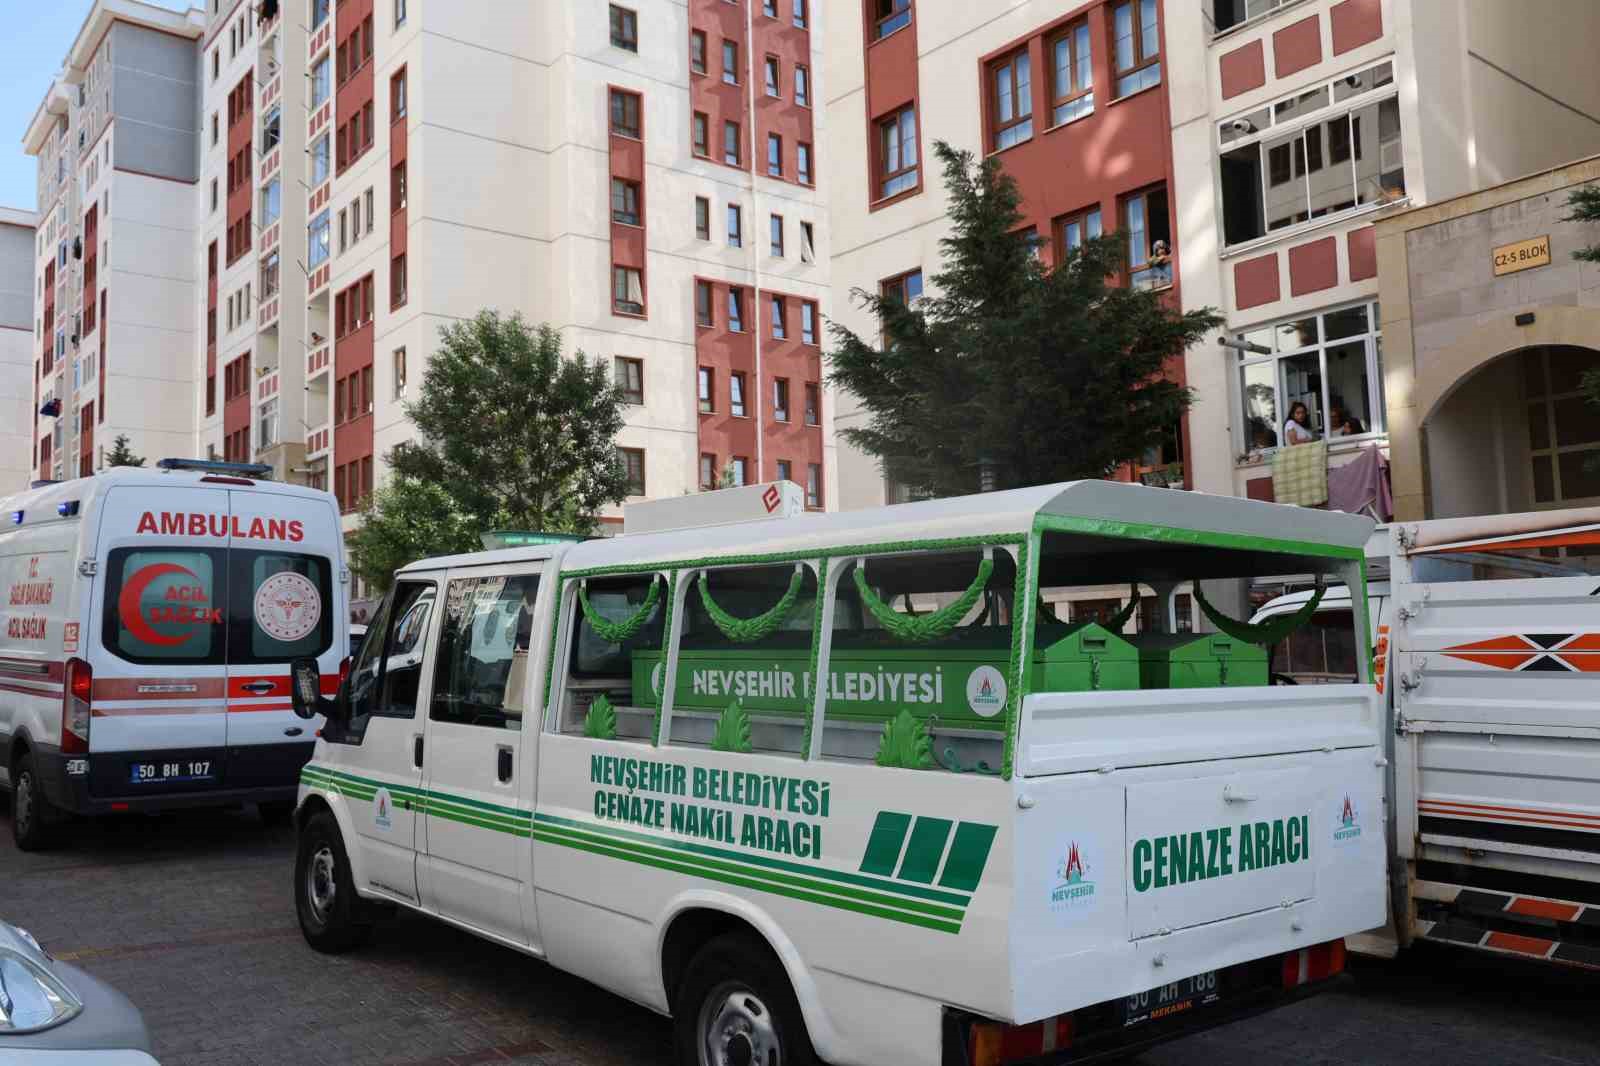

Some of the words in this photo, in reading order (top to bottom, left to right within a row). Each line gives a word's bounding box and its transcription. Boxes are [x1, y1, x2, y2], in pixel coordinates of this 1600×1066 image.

[1519, 244, 1547, 261] BLOK
[136, 511, 304, 542] AMBULANS
[692, 664, 796, 705] NEVŞEHİR
[139, 764, 155, 778] 50
[163, 763, 179, 777] BH
[188, 762, 210, 776] 107
[590, 754, 687, 793] NEVŞEHİR
[692, 766, 831, 817] BELEDİYESİ
[594, 790, 665, 829] CENAZE
[670, 802, 736, 845] NAKİL
[740, 814, 821, 860] ARACI
[1133, 826, 1233, 893] CENAZE
[1238, 815, 1309, 872] ARACI
